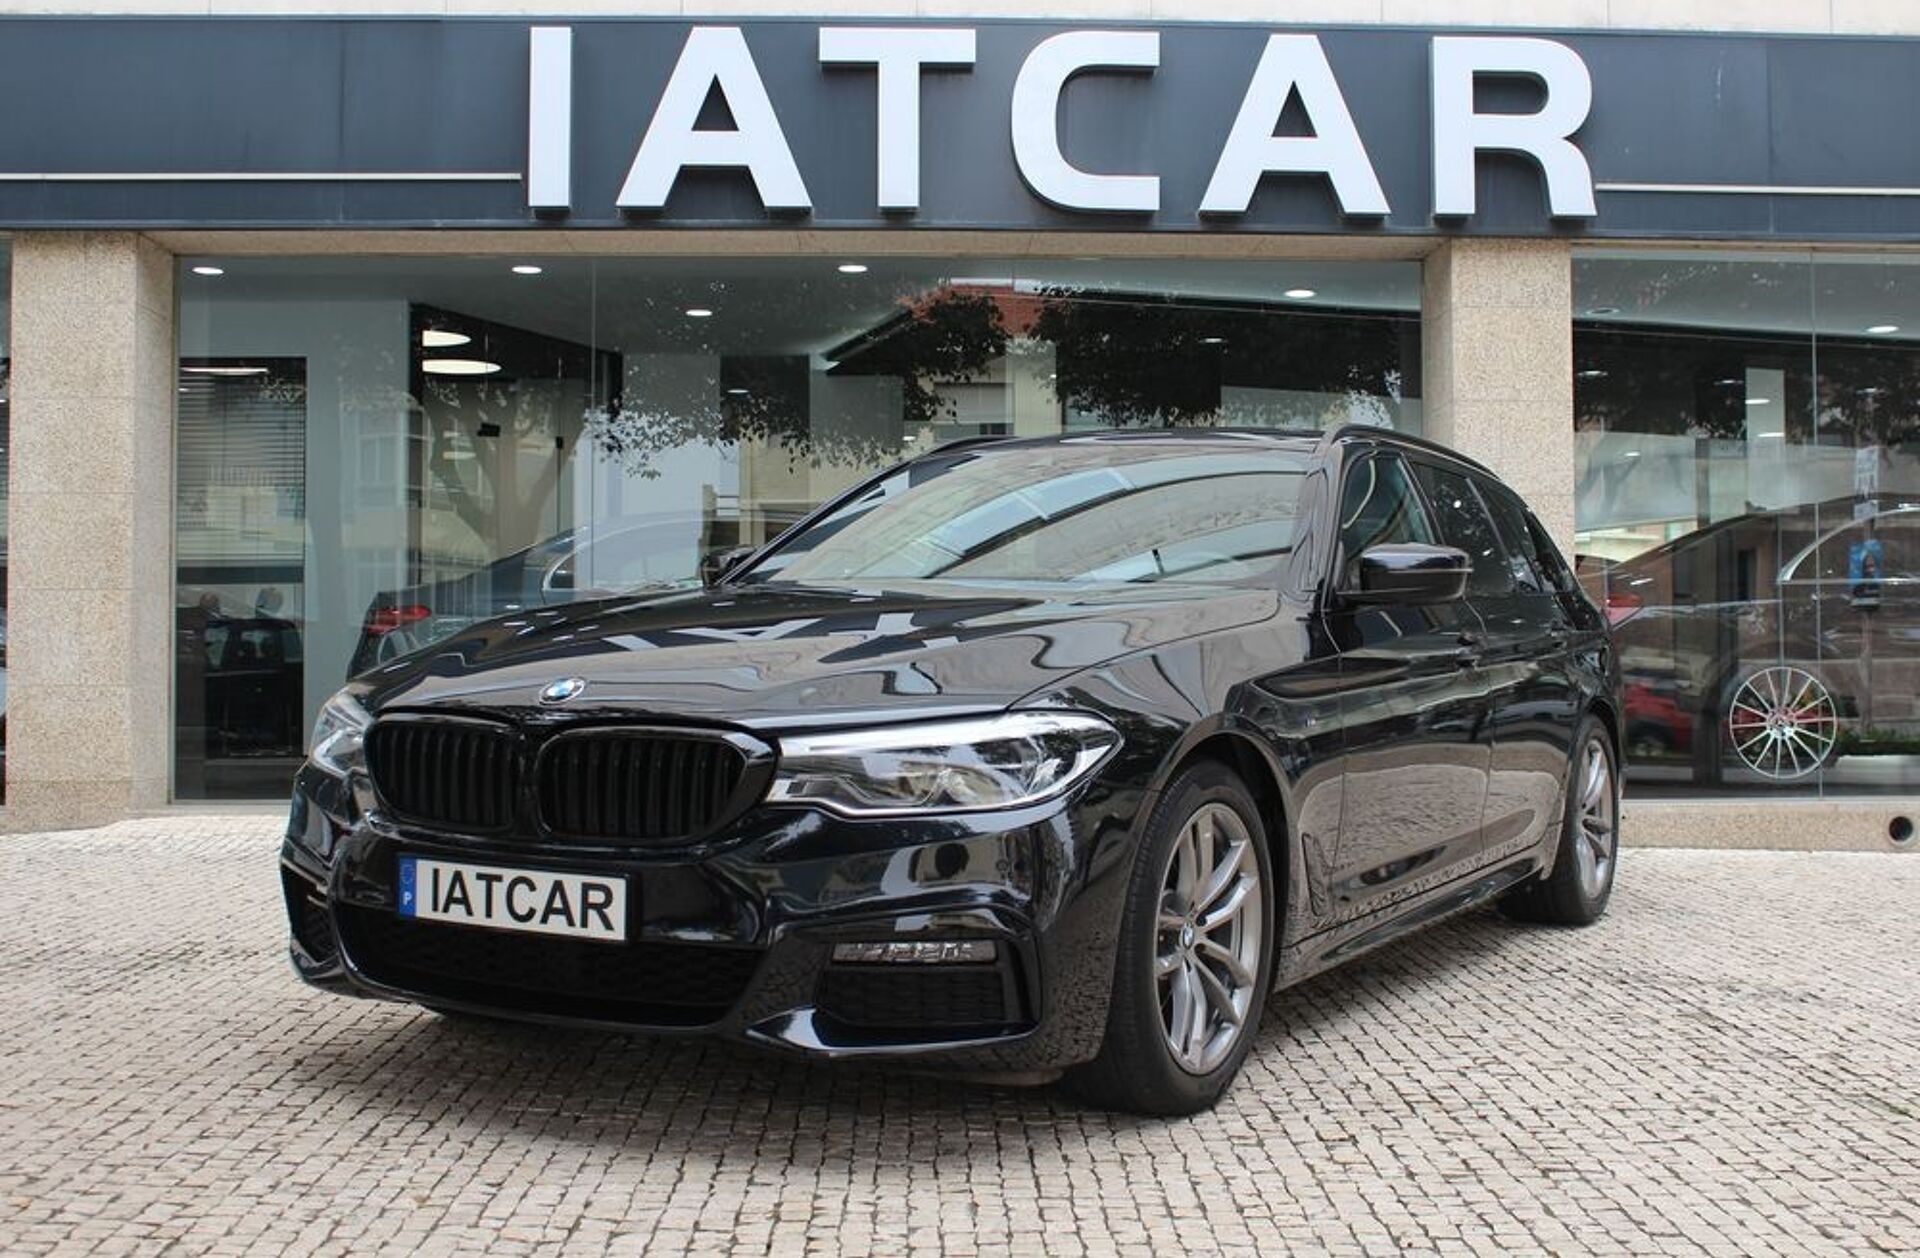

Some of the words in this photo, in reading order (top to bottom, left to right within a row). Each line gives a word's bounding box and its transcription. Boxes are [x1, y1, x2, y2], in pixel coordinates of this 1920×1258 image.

[528, 26, 1598, 217] IATCAR
[402, 891, 412, 906] P
[431, 867, 615, 931] IATCAR
